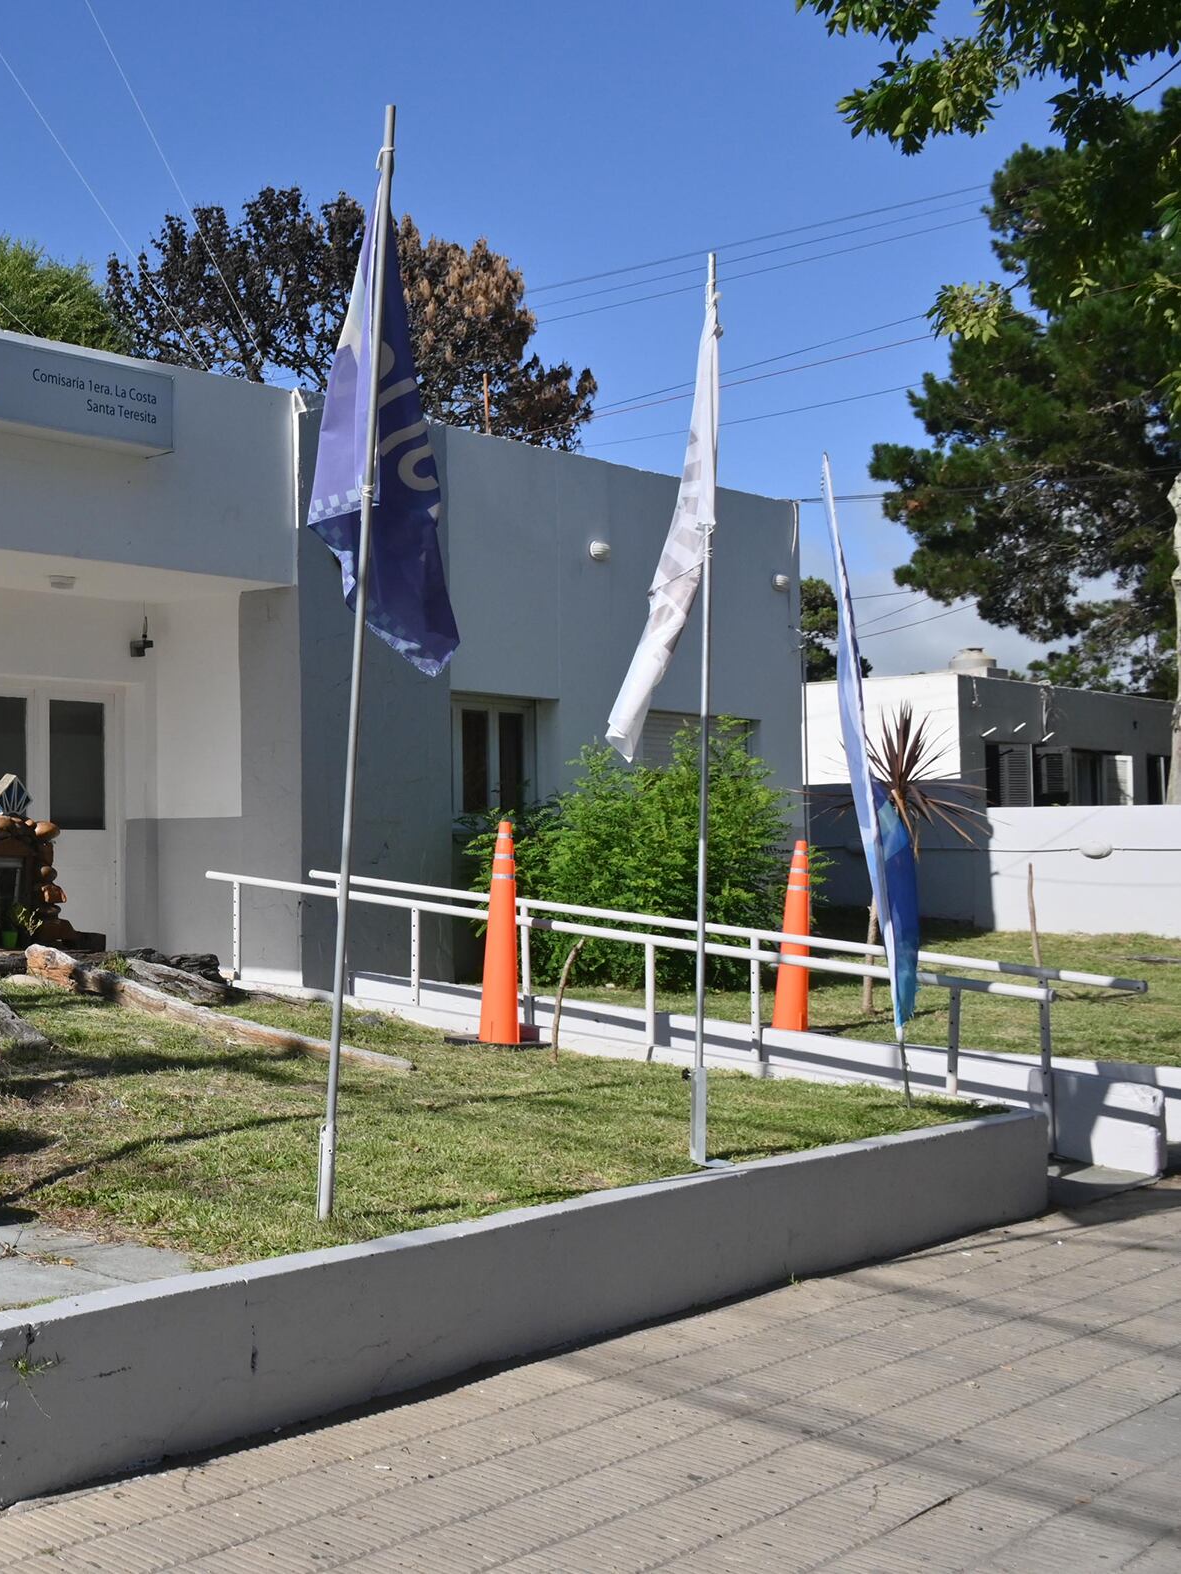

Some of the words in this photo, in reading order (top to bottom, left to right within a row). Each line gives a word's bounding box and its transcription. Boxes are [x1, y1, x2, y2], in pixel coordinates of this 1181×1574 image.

[88, 380, 113, 396] 1era.
[115, 385, 126, 398] La
[129, 388, 157, 405] Costa
[86, 399, 115, 416] Santa
[118, 405, 157, 424] Teresita
